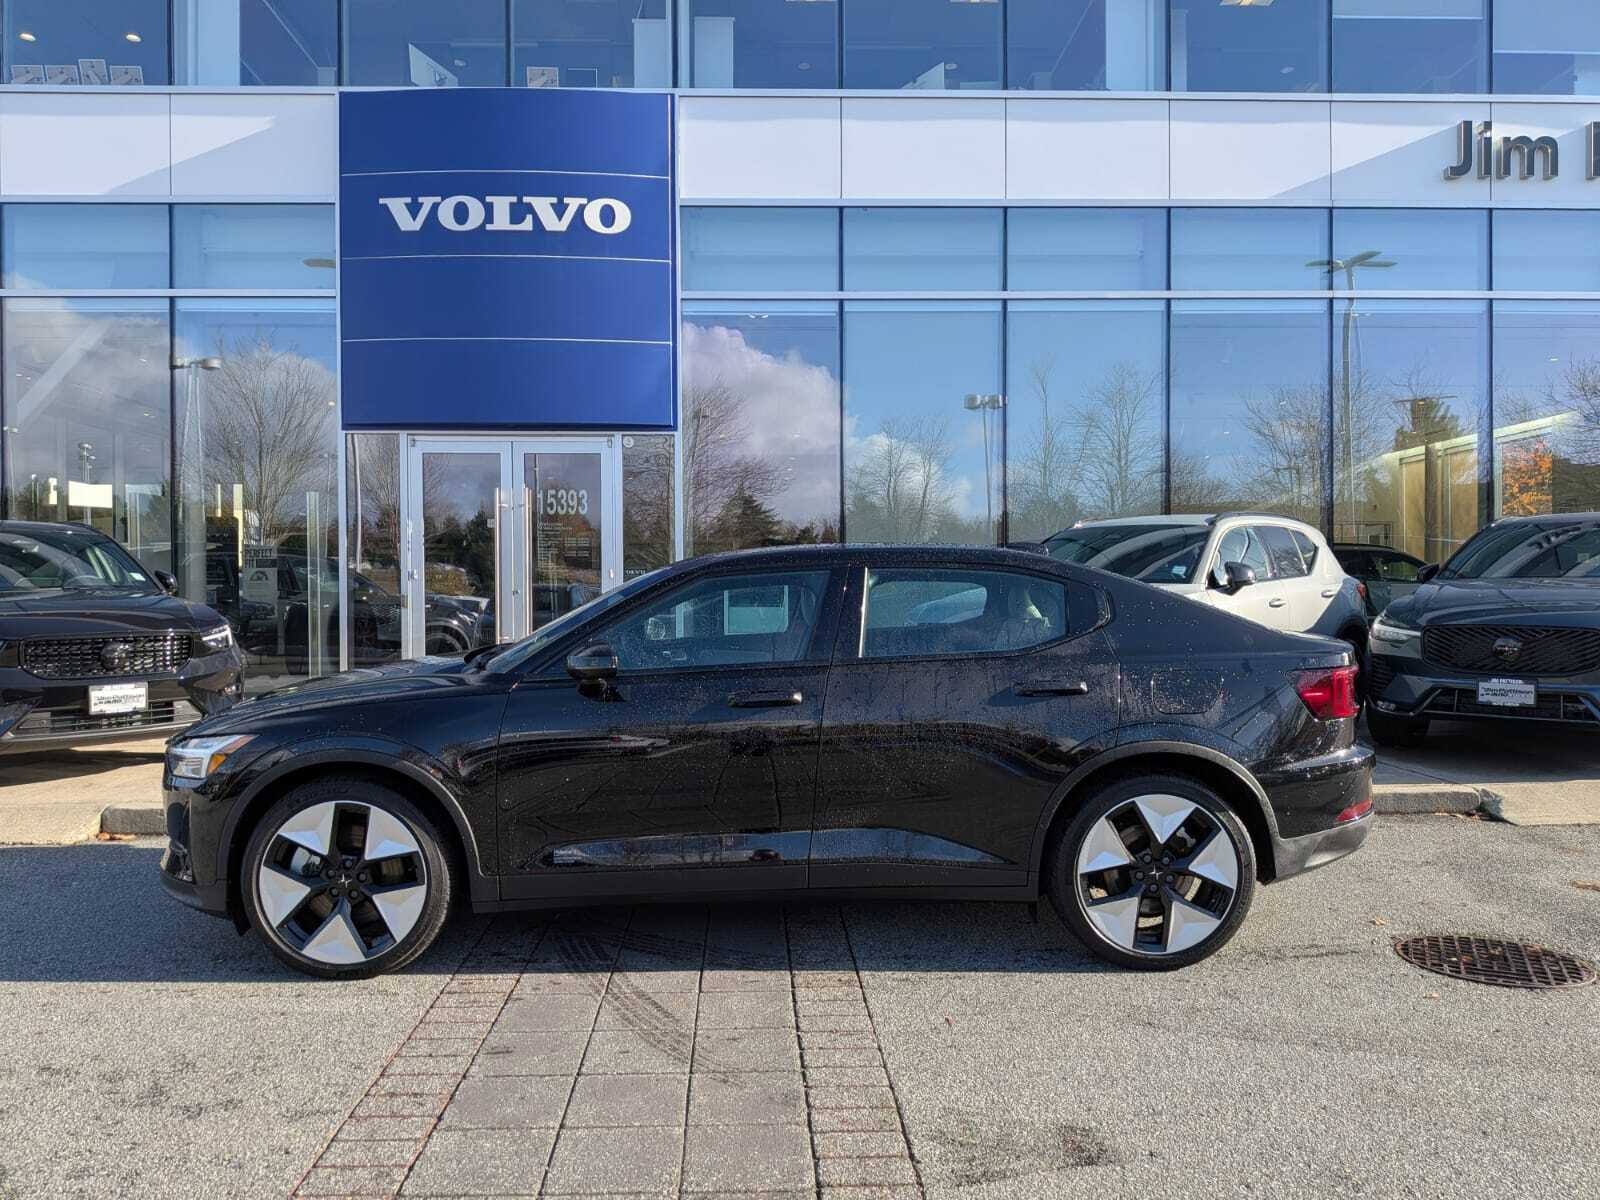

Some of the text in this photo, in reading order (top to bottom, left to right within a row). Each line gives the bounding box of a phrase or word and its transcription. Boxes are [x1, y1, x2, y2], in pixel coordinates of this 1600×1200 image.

[1441, 120, 1558, 180] Jim
[378, 195, 632, 234] VOLVO
[537, 489, 588, 515] 15393
